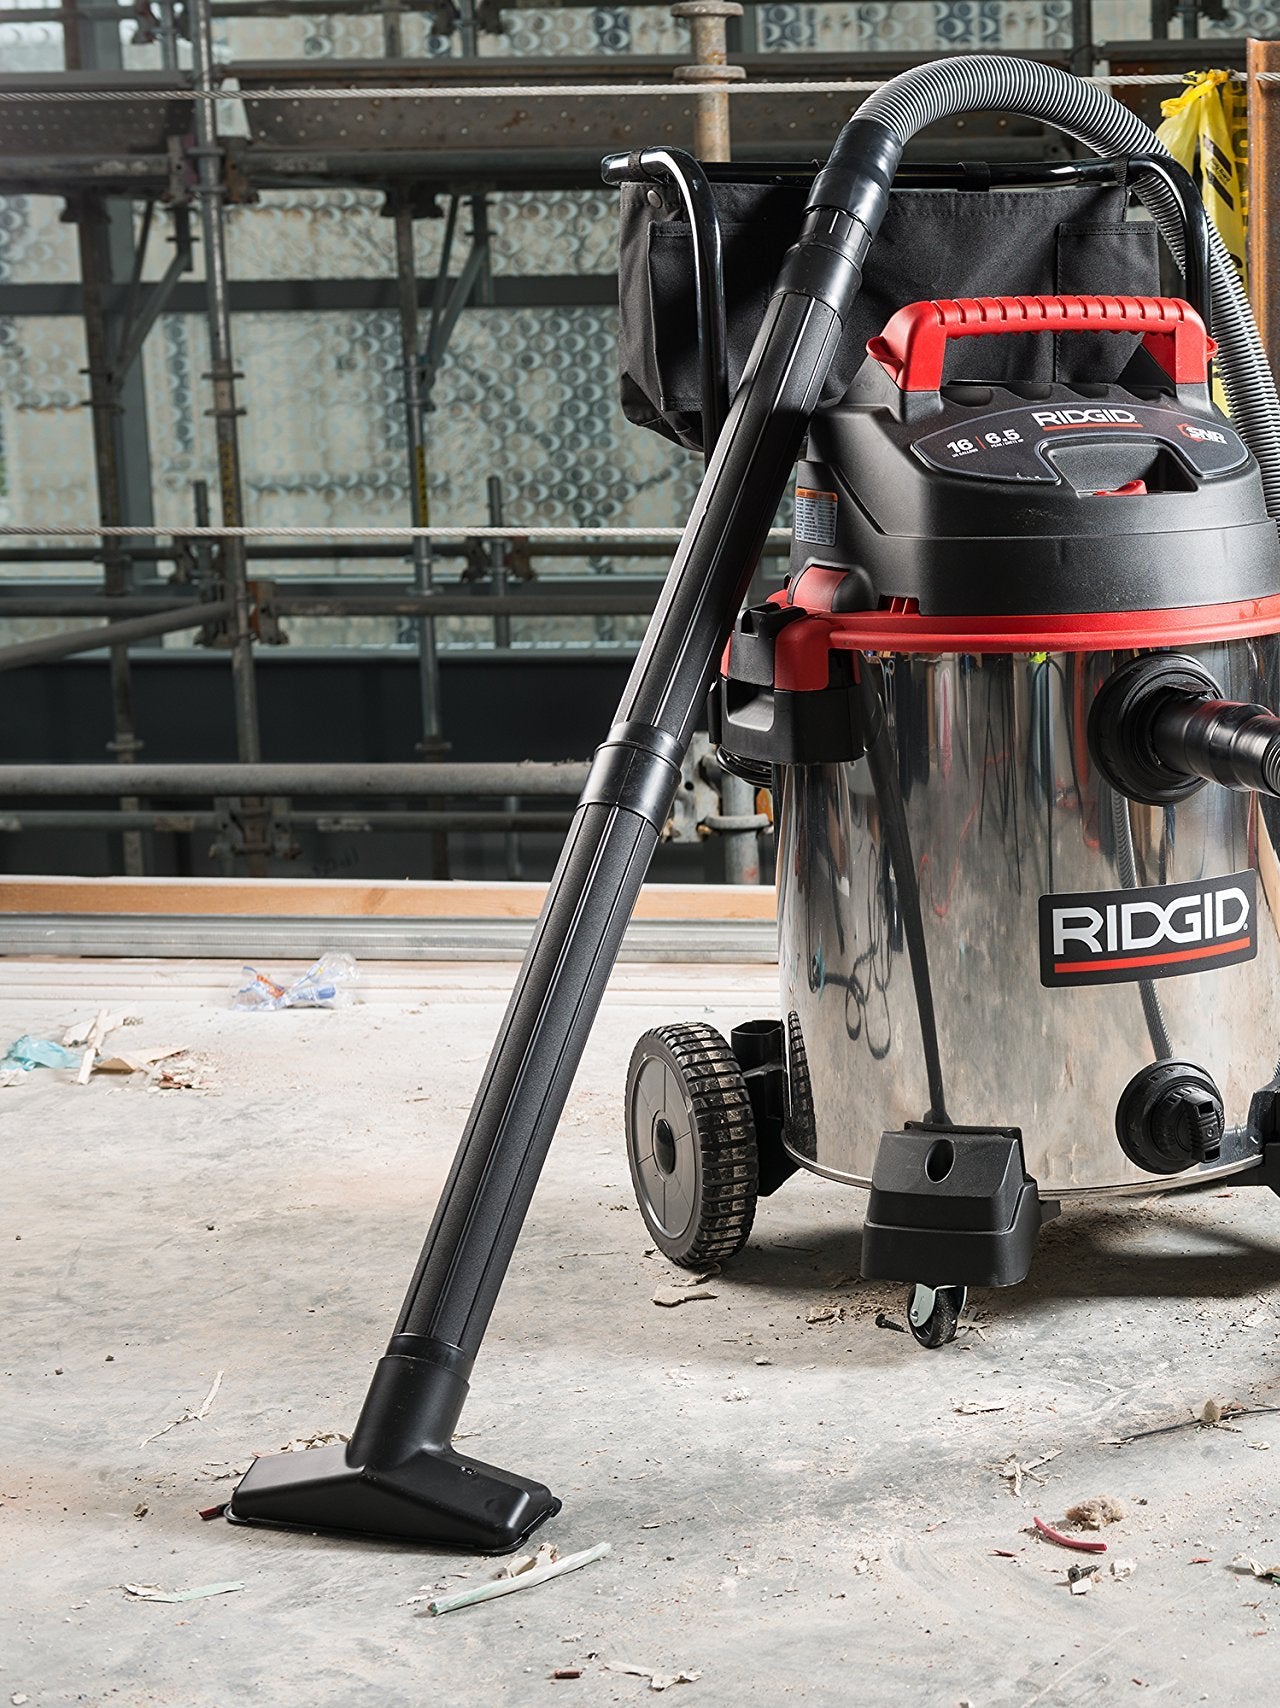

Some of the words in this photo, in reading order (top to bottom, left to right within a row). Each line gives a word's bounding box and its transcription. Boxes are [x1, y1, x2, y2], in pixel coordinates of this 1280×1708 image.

[1031, 408, 1137, 427] RIDGID
[946, 438, 974, 453] 16
[984, 428, 1021, 444] 6.5
[1052, 887, 1250, 956] RIDGID
